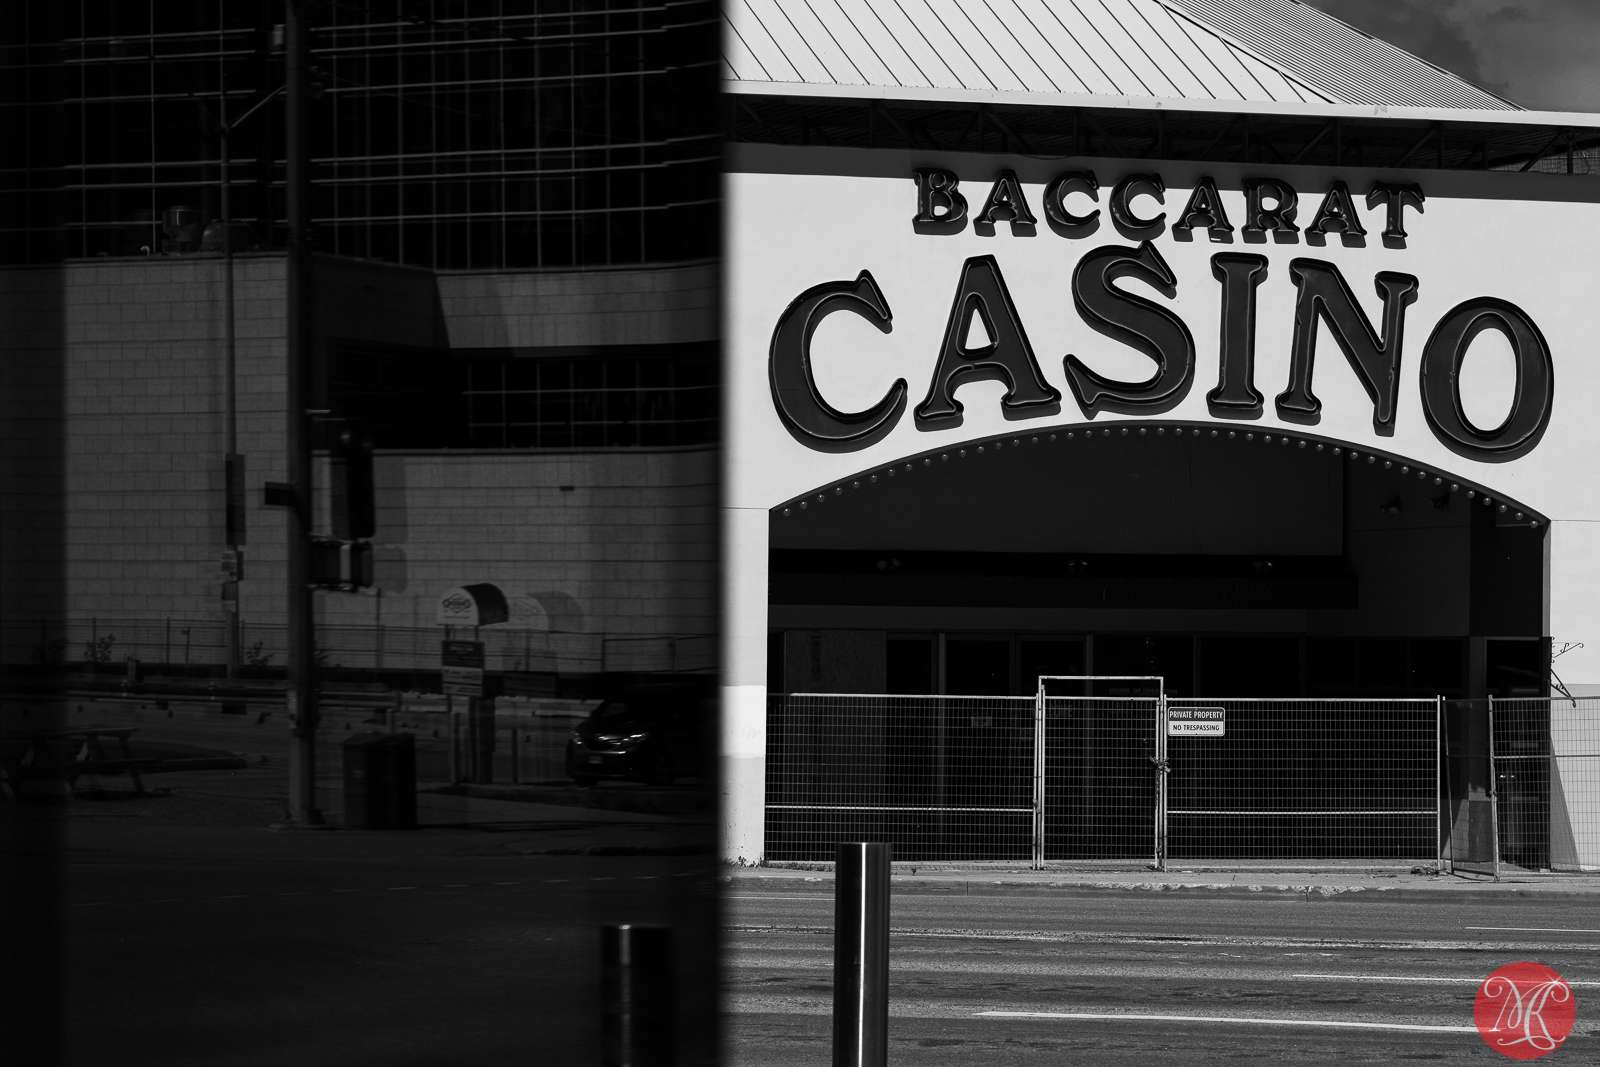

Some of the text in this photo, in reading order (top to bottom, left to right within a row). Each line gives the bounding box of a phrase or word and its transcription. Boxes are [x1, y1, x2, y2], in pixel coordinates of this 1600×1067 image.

[913, 167, 1425, 249] BACCARAT
[768, 240, 1554, 463] CASINO
[1142, 687, 1178, 695] OPERTION
[1169, 710, 1224, 719] PRIVATE PROPERTY
[1183, 724, 1220, 732] TRESPASSING
